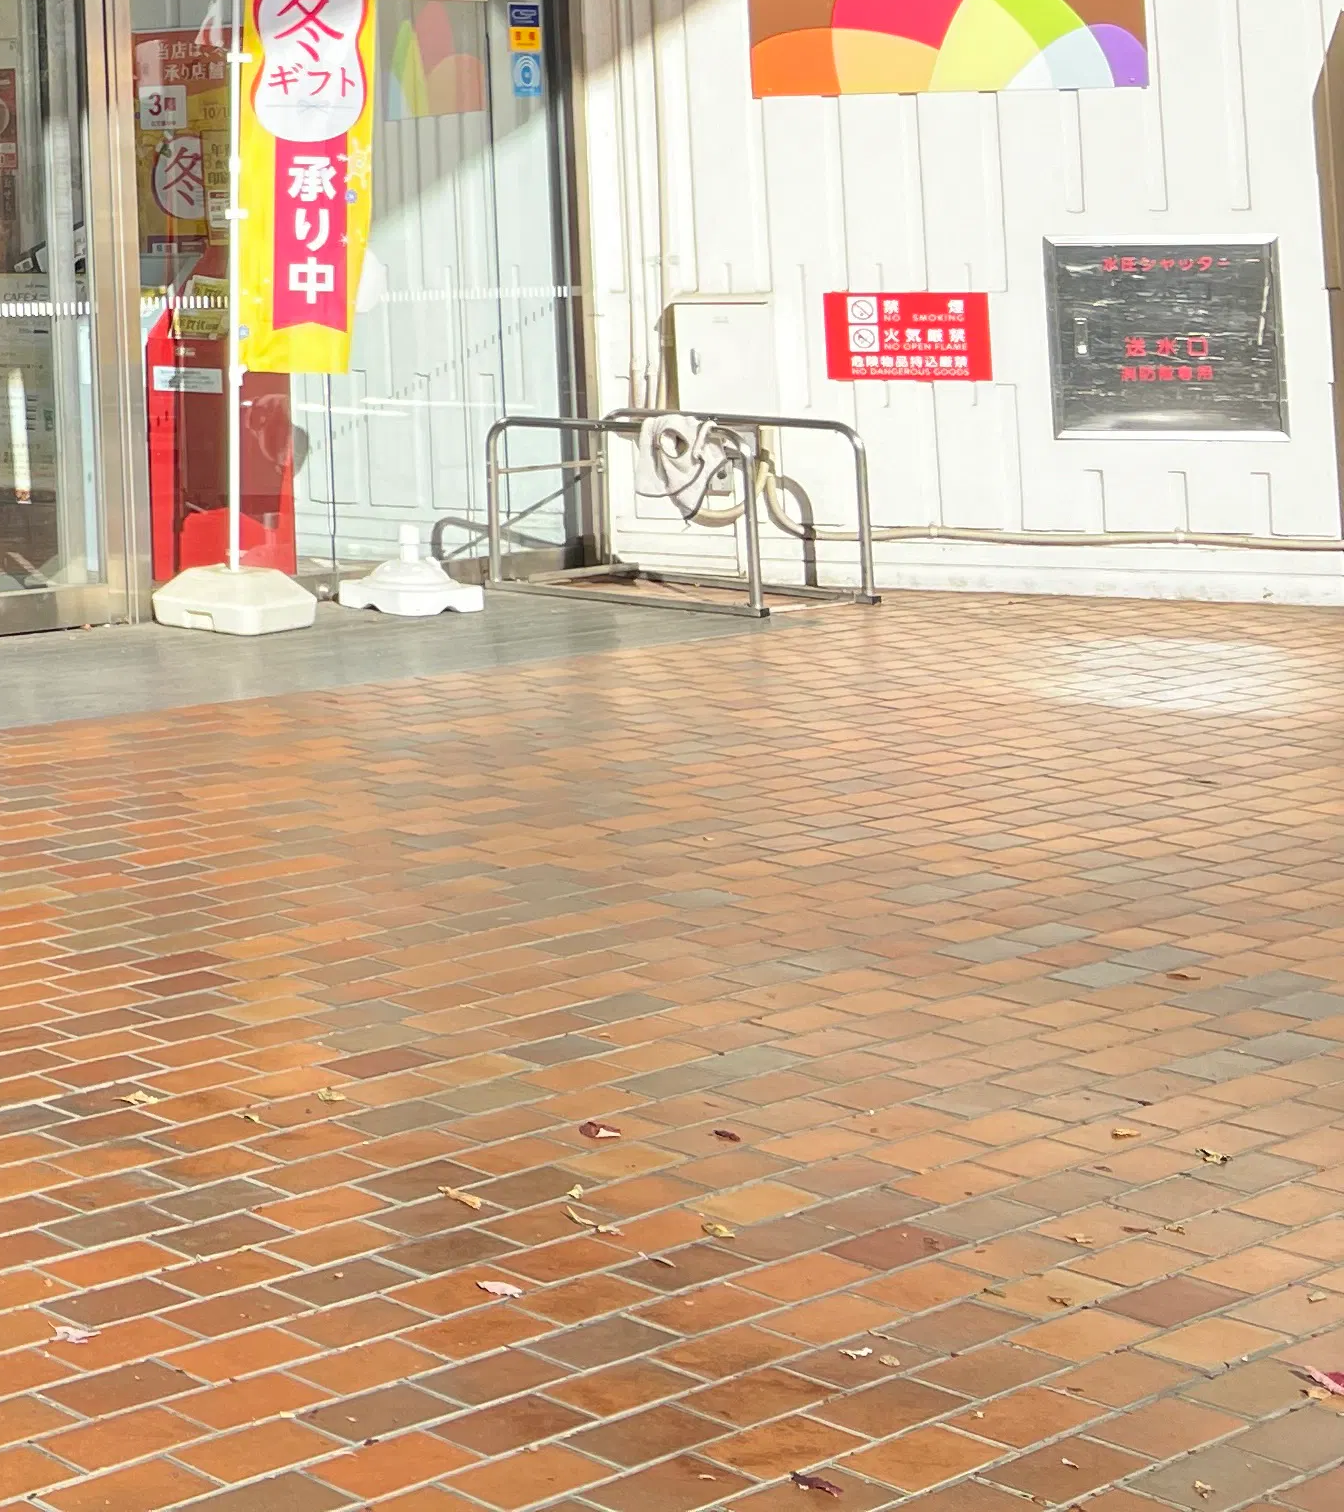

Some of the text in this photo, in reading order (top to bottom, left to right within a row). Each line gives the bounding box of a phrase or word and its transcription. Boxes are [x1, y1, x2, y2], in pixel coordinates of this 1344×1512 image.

[268, 64, 357, 98] ギフト
[163, 146, 203, 206] 冬
[287, 156, 338, 305] 承り中
[884, 314, 965, 322] NO SMOKING
[884, 343, 968, 351] NO OPEN FLAME
[1124, 336, 1209, 358] 送水口
[851, 368, 970, 376] NO DANGEROUS GOODS
